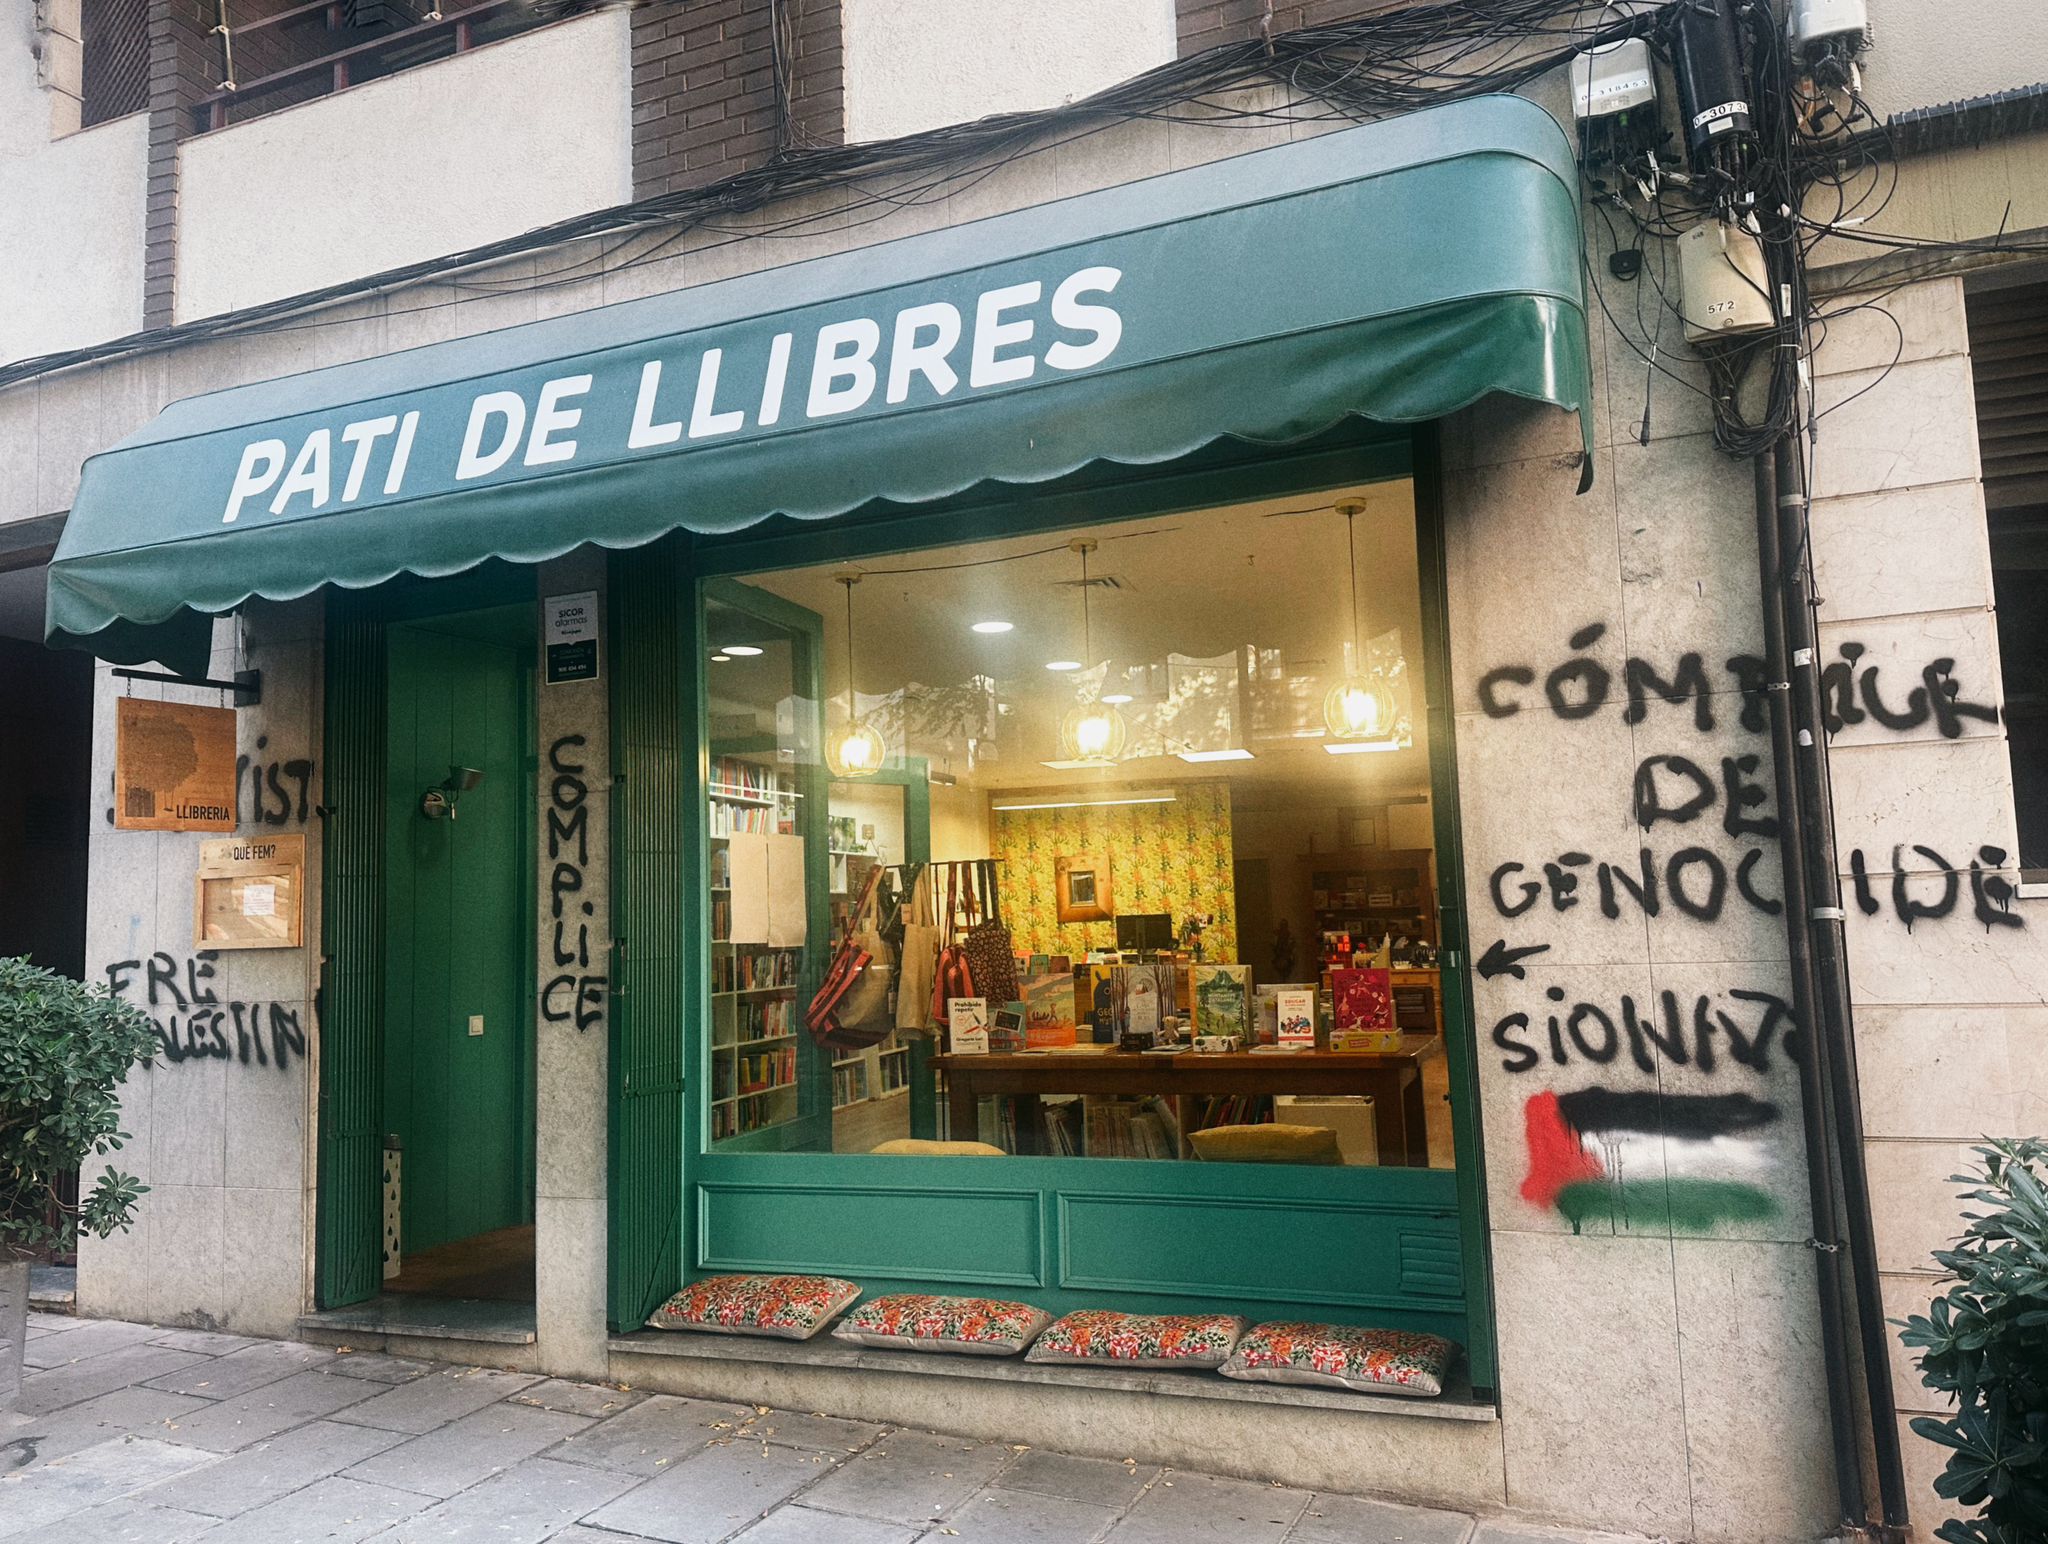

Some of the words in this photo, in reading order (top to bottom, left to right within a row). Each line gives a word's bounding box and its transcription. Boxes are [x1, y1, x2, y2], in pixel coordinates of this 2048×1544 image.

[1708, 300, 1735, 314] 572
[222, 411, 420, 523] PATI
[455, 374, 593, 480] DE
[627, 266, 1123, 449] LLIBRES
[558, 607, 584, 618] SICOR
[554, 616, 588, 628] alarmas
[1633, 754, 1780, 837] DE
[176, 804, 230, 821] LLIBRERIA
[233, 842, 251, 860] QUÈ
[252, 843, 276, 860] FEM?
